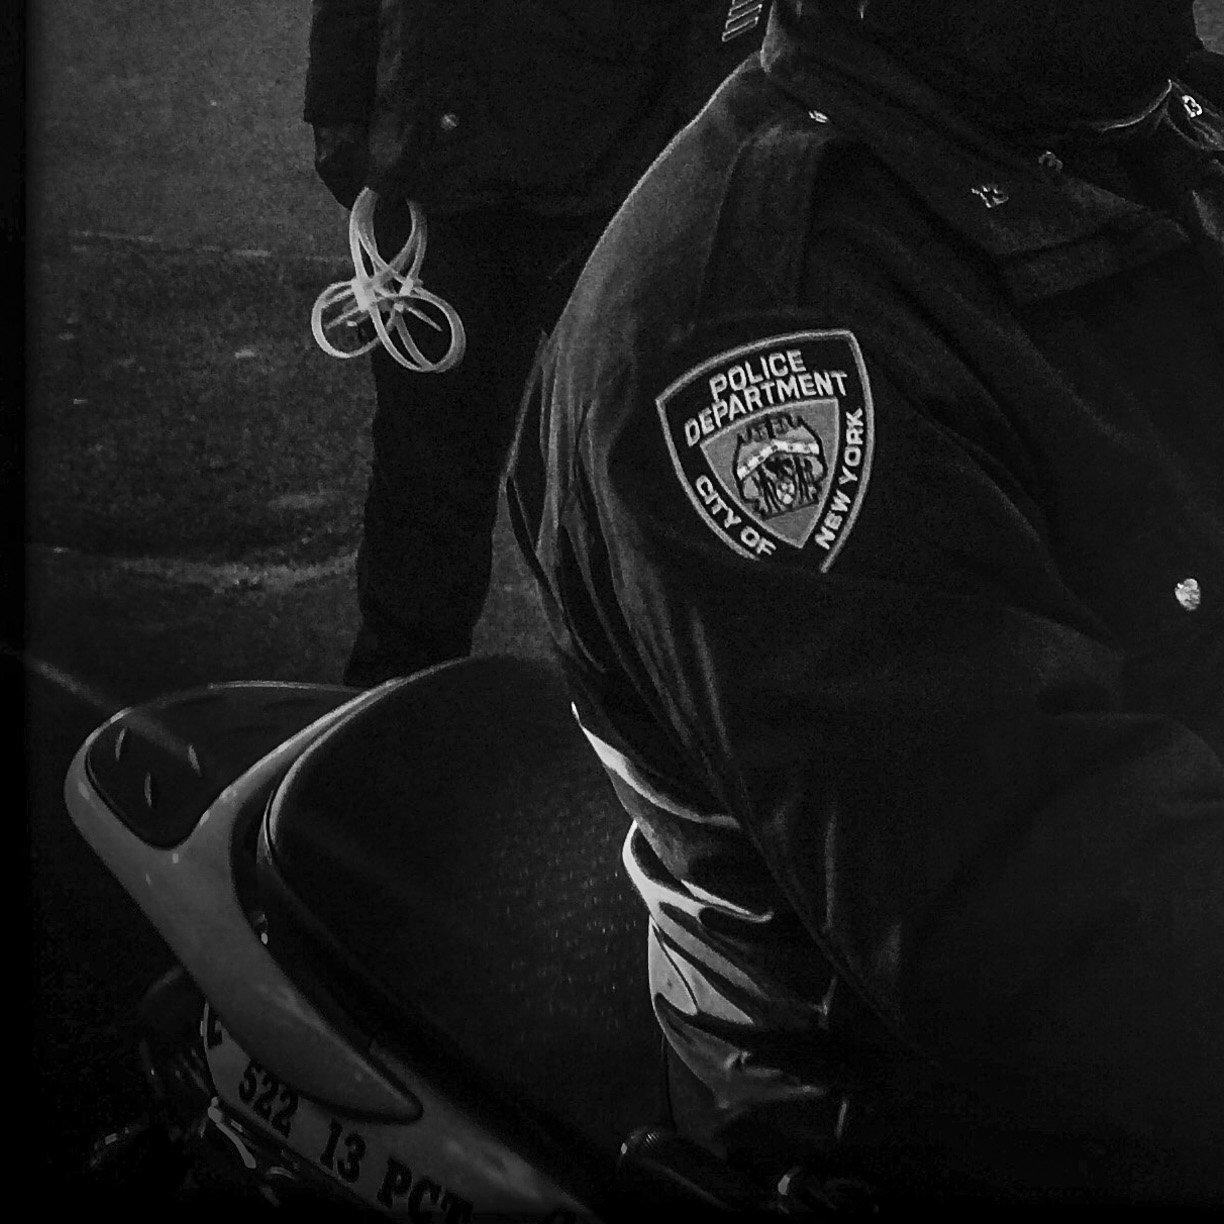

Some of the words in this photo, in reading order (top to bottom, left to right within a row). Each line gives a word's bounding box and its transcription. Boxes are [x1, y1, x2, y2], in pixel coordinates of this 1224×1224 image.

[684, 369, 848, 448] DEPARTMENT
[708, 348, 807, 404] POLICE
[696, 474, 743, 529] CITY
[740, 525, 778, 556] OF
[814, 488, 852, 551] NEW
[837, 407, 865, 486] YORK
[238, 1059, 299, 1139] 522
[319, 1118, 367, 1184] 13
